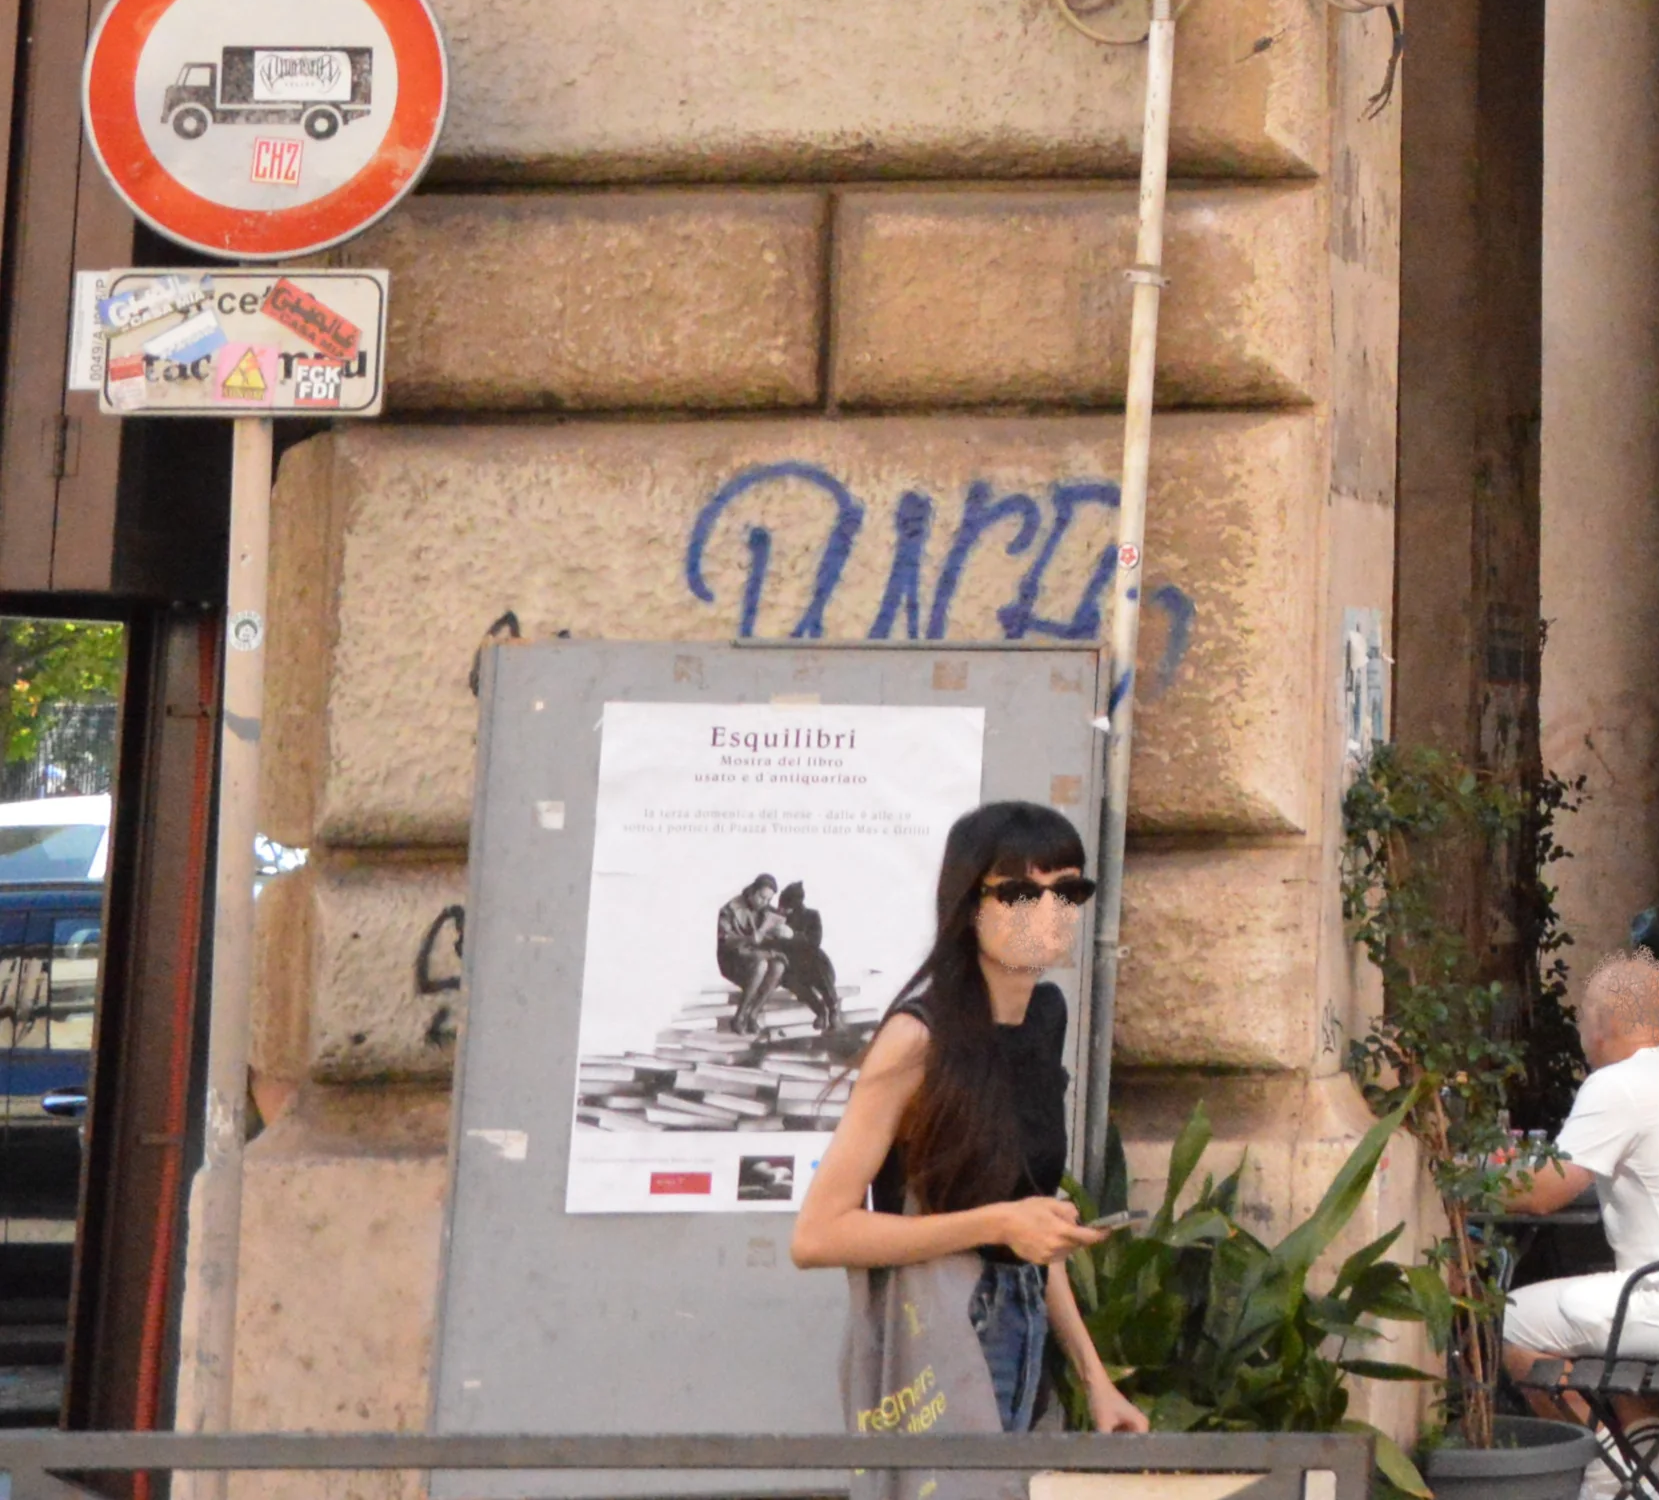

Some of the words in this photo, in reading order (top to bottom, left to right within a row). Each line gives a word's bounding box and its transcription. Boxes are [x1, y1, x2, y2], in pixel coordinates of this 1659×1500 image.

[296, 365, 341, 385] FCK
[298, 383, 336, 399] FDI
[710, 726, 857, 752] Esquilibri
[720, 754, 772, 767] Mostra
[778, 755, 801, 767] del
[807, 755, 843, 768] libro
[694, 772, 736, 783] usato
[694, 808, 754, 819] domenica
